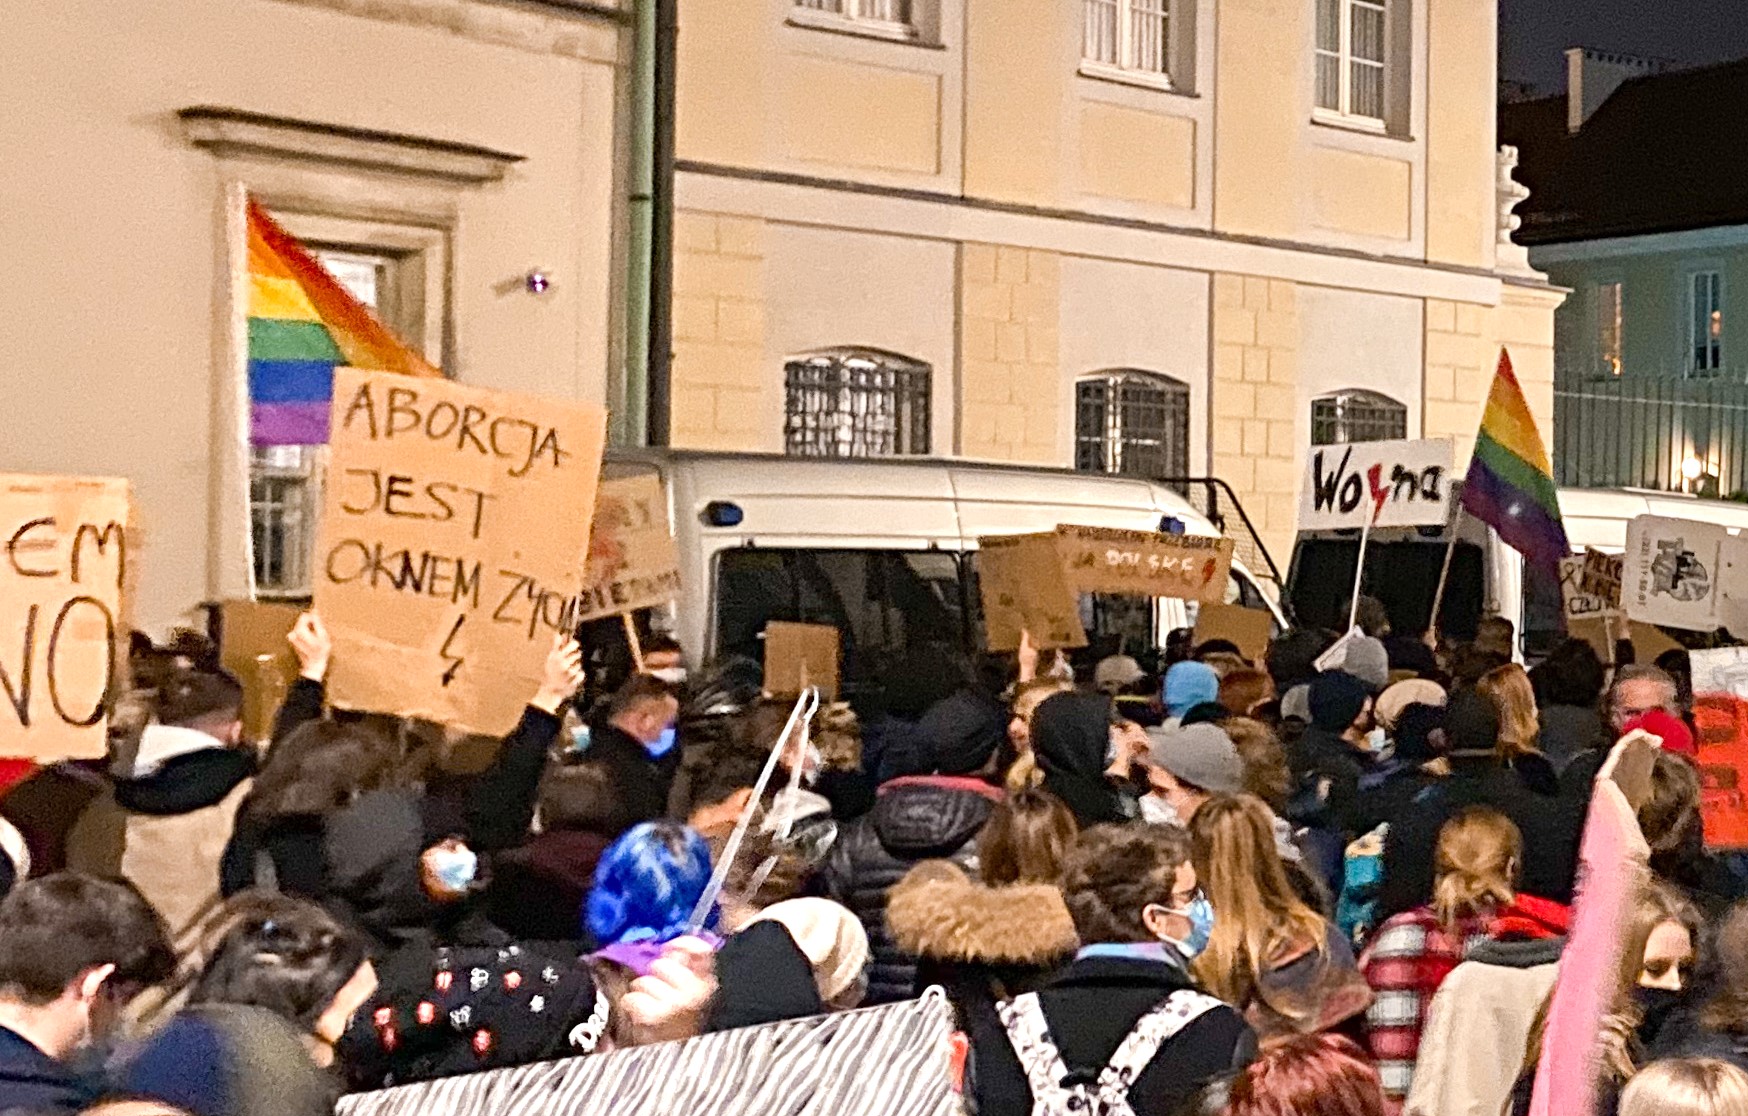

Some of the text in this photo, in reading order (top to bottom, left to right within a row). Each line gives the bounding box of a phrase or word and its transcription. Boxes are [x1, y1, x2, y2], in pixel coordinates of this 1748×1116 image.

[343, 382, 572, 478] ABORCJA
[341, 467, 499, 539] JEST
[326, 538, 481, 609] OKNEM
